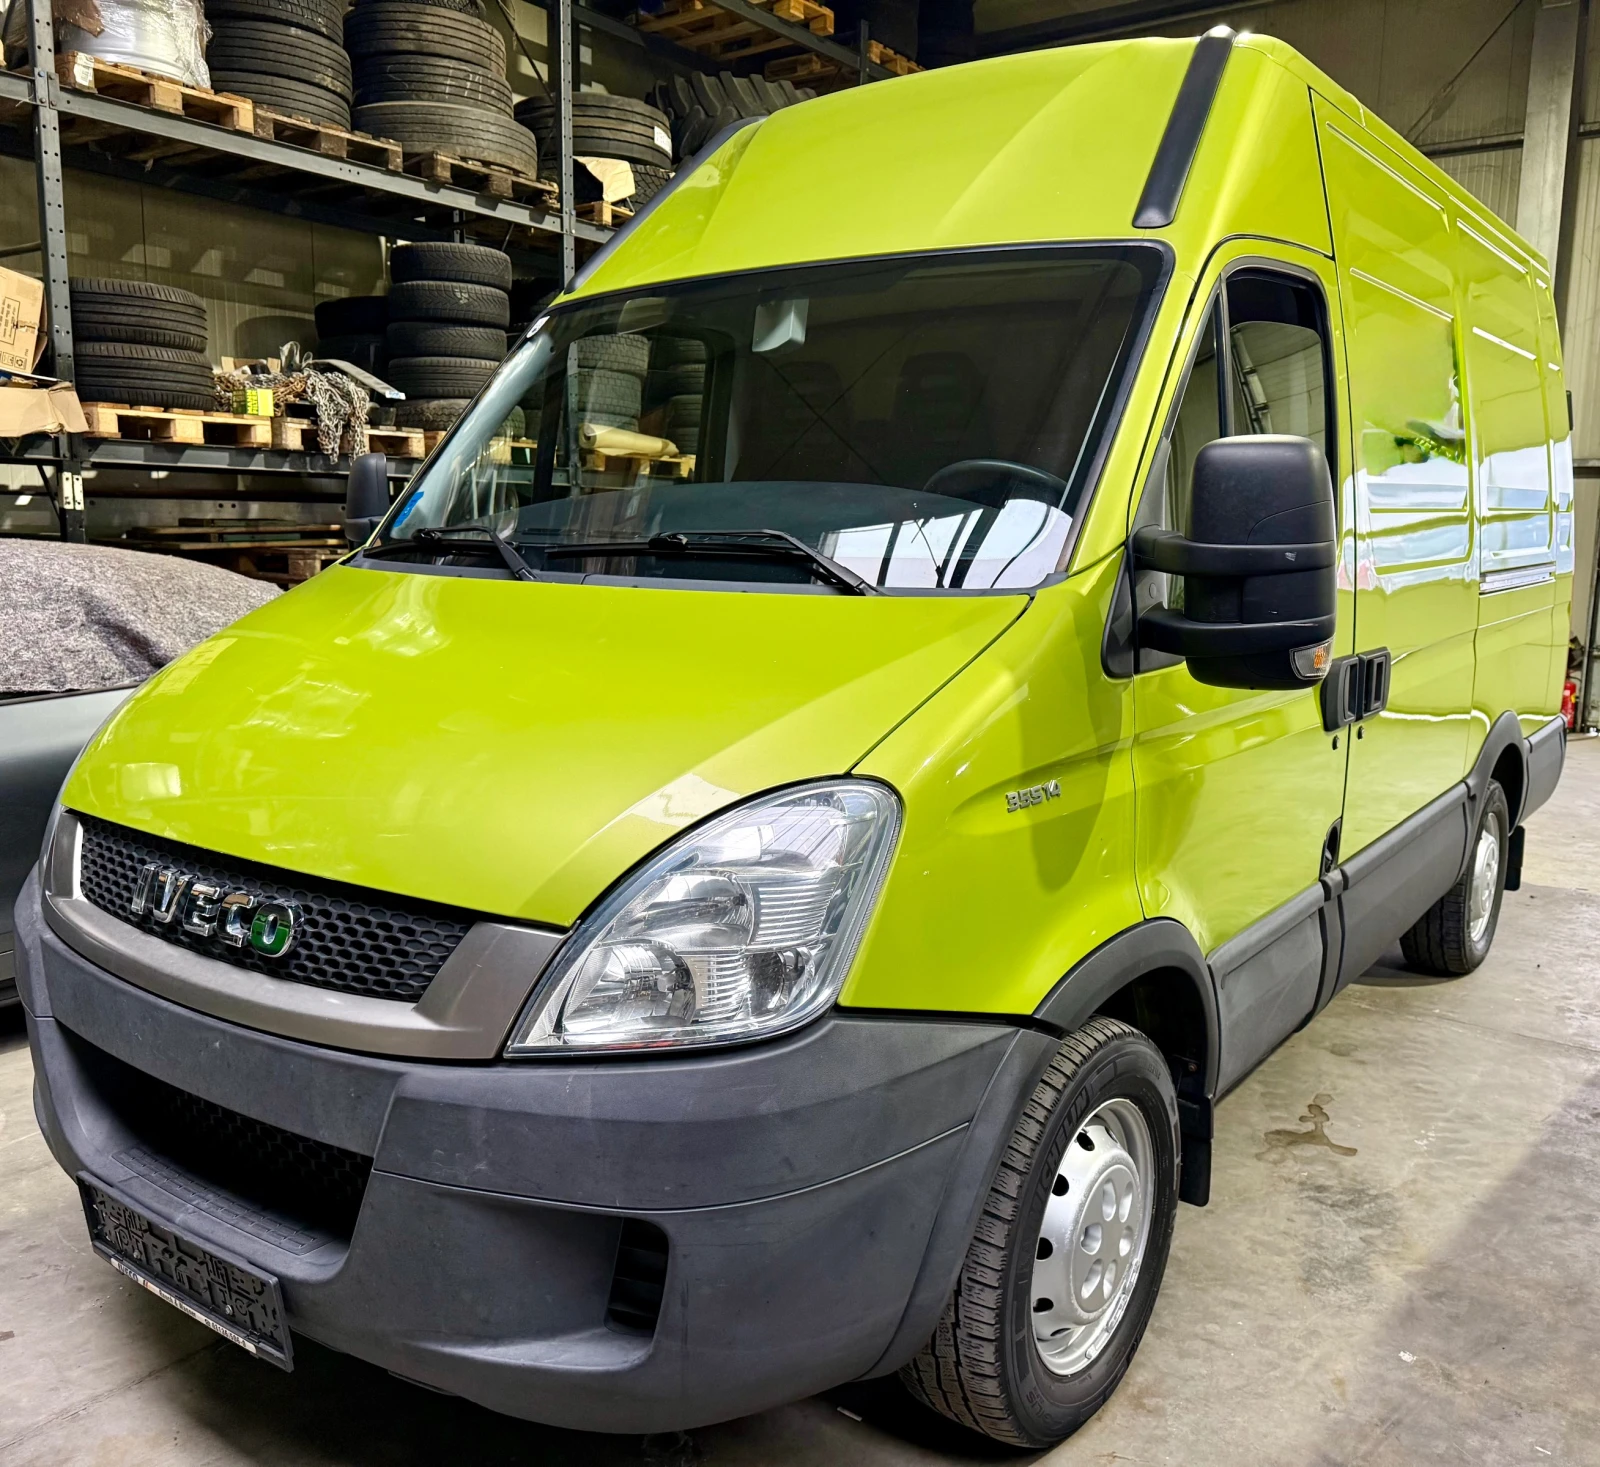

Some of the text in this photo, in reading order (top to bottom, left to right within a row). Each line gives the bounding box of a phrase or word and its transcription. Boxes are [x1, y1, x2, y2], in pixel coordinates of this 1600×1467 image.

[1005, 780, 1061, 813] 35S14
[132, 862, 304, 958] IVECO
[118, 1262, 138, 1281] IVECO
